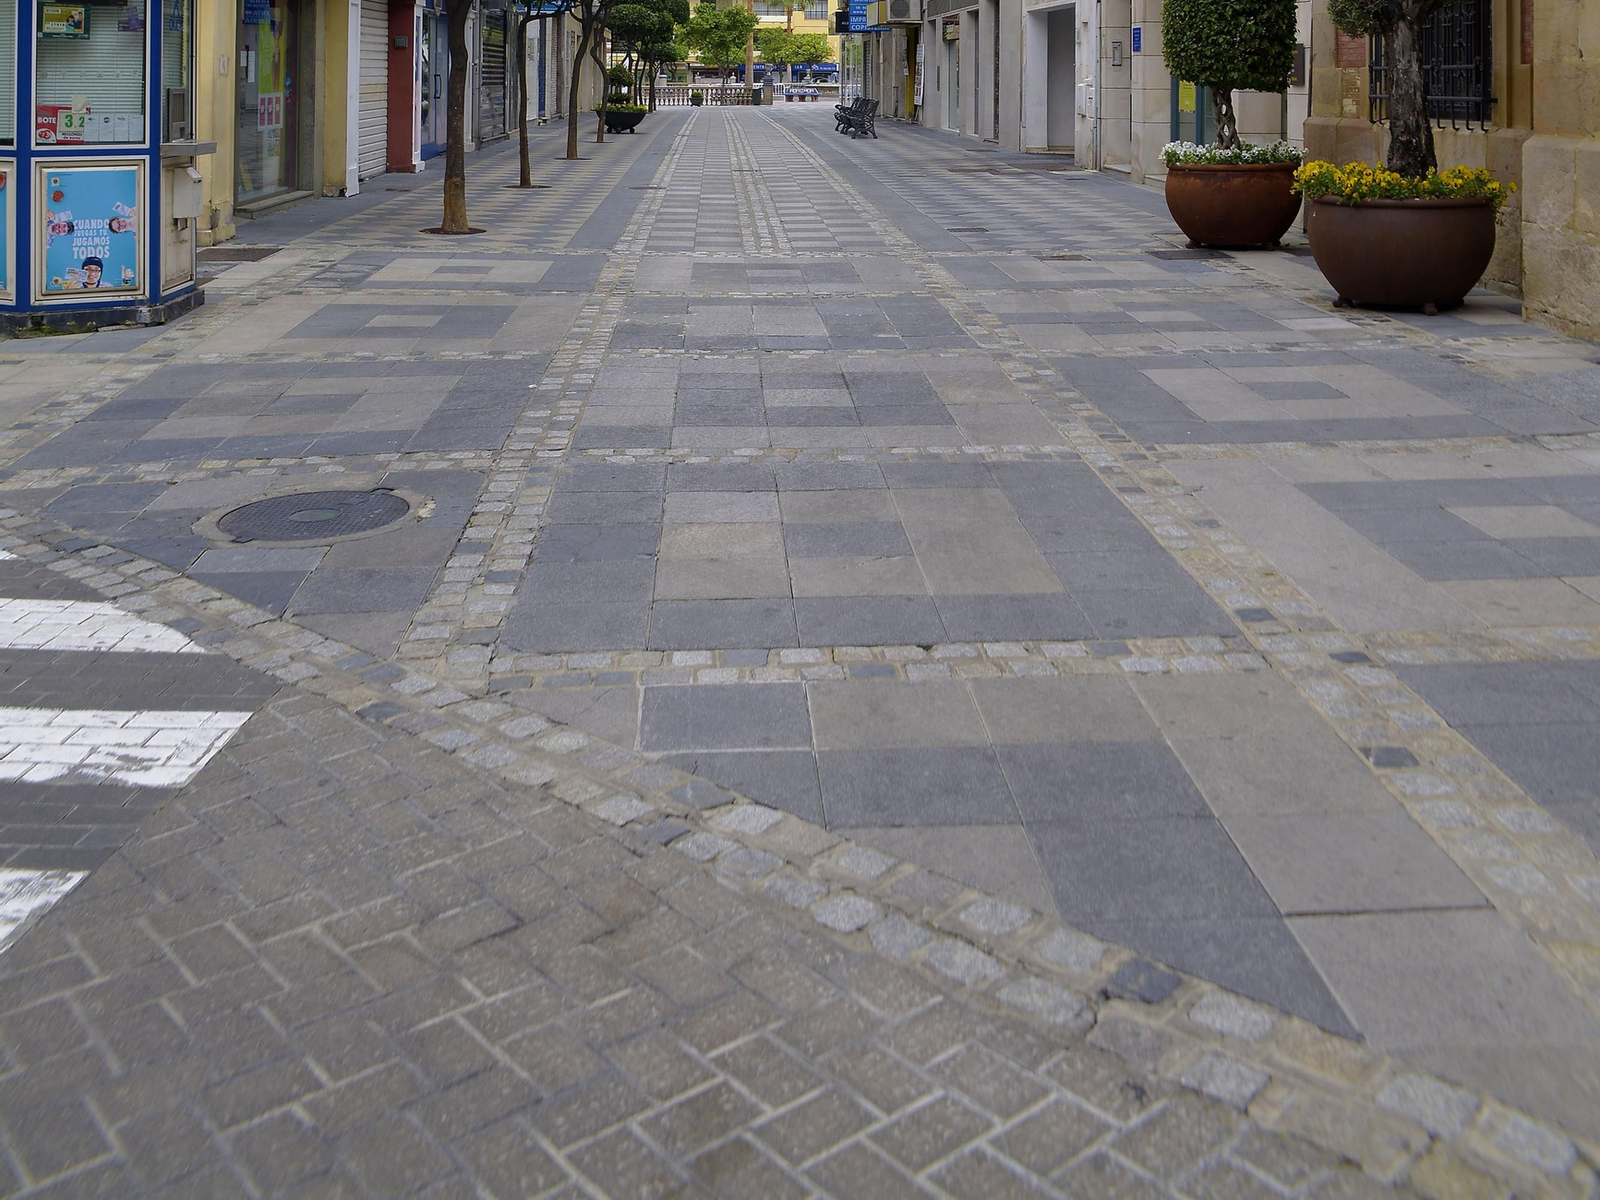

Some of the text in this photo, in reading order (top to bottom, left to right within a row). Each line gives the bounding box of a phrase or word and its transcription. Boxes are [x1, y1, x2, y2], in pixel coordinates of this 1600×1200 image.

[37, 116, 56, 124] BOTE
[73, 219, 109, 230] CUANDO
[73, 236, 110, 247] JUGAMOS
[72, 246, 110, 260] TODOS
